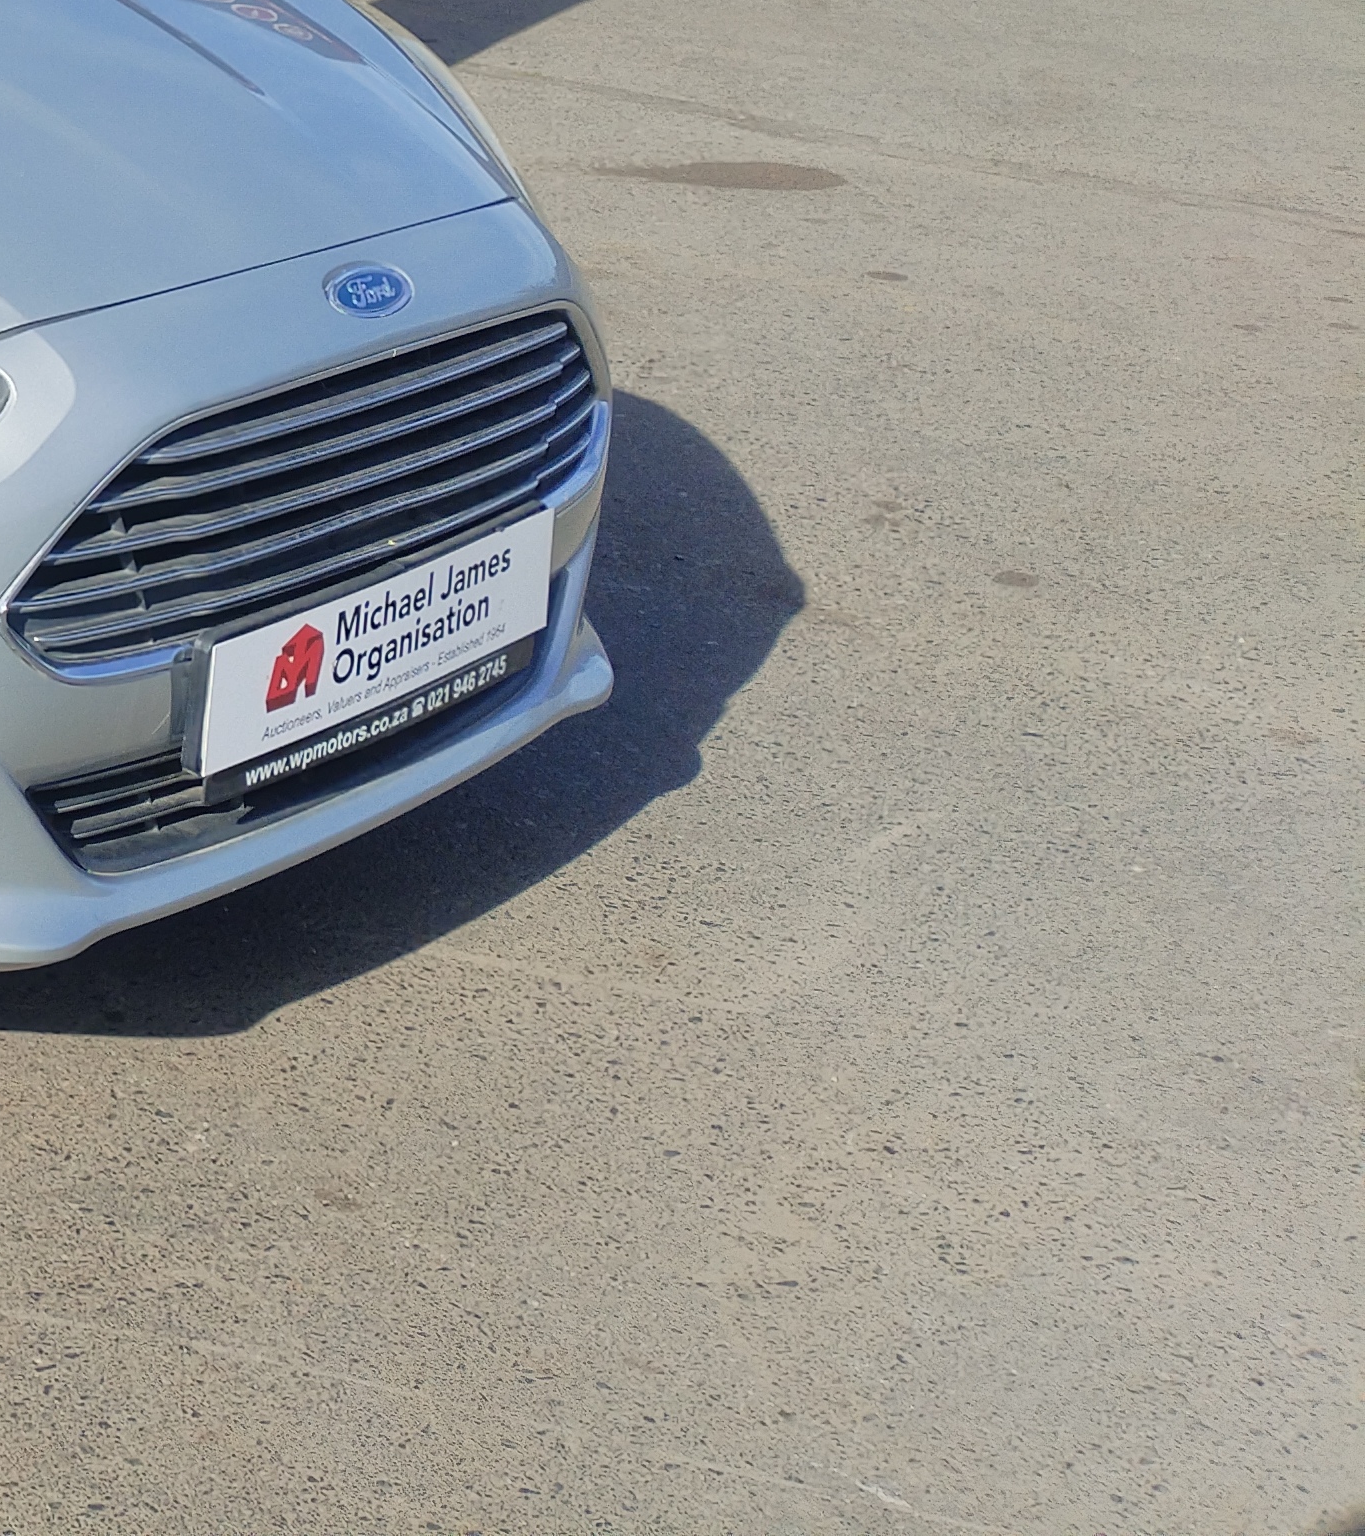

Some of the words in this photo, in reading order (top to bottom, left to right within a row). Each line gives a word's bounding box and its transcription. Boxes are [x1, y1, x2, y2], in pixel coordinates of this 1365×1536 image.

[345, 274, 396, 308] Ford
[332, 596, 490, 684] Organisation
[335, 571, 434, 646] Michael
[441, 548, 511, 600] James
[327, 687, 363, 714] Valuers
[364, 680, 382, 699] and
[382, 661, 430, 695] Appraisers
[437, 636, 484, 667] Established
[245, 706, 409, 787] www.wpmotors.co.za
[426, 688, 451, 712] 021
[452, 674, 477, 699] 946
[477, 654, 508, 687] 2745
